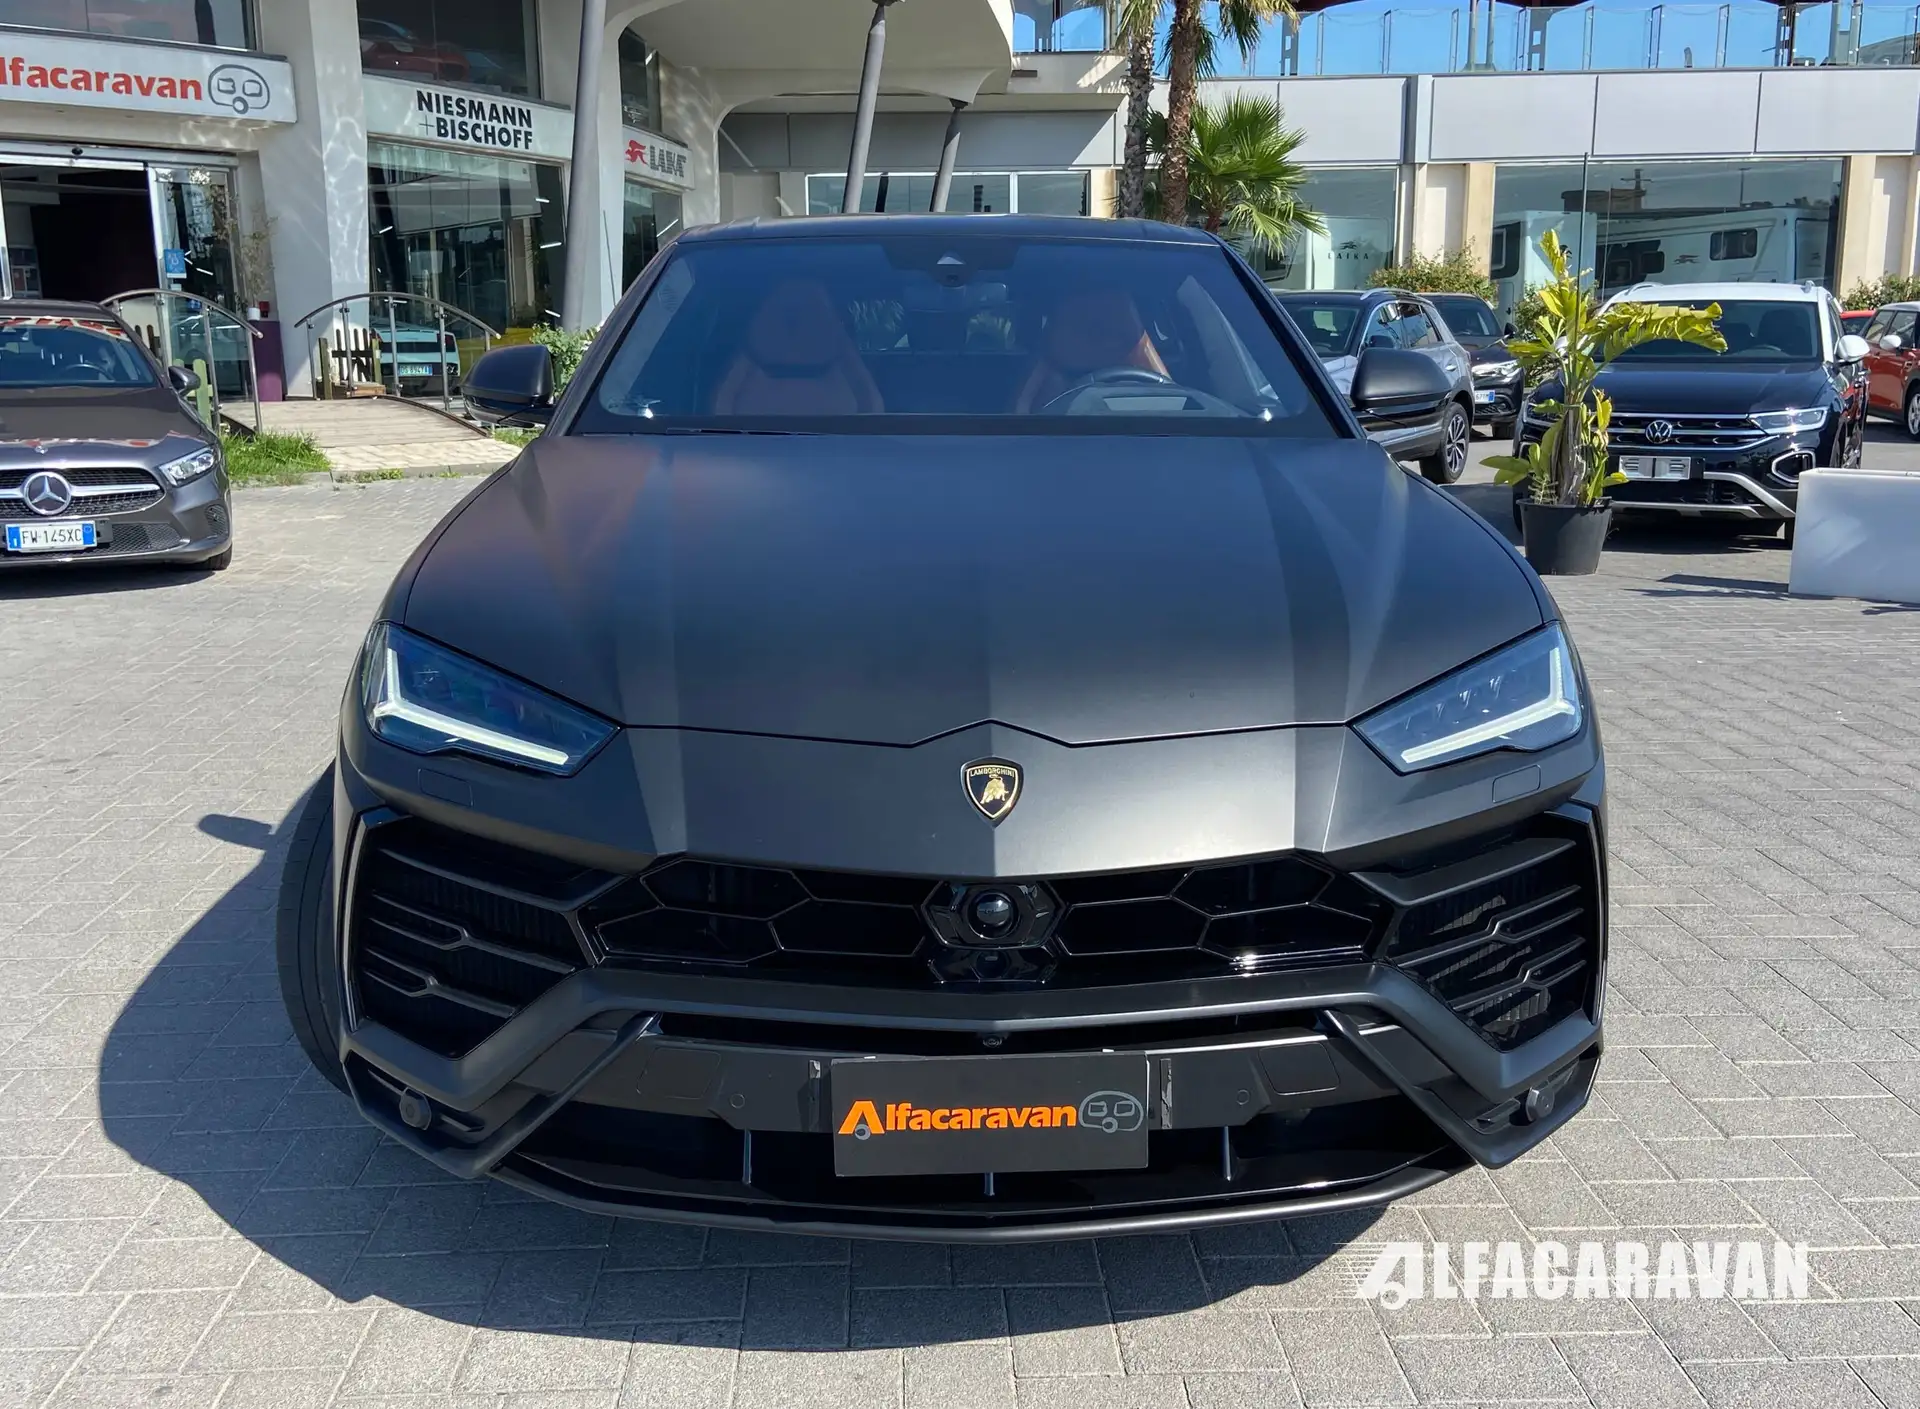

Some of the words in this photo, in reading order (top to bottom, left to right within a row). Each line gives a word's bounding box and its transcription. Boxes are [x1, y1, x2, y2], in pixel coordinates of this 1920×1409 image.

[0, 56, 203, 101] lfacaravan
[416, 90, 533, 128] NIESMANN
[1327, 252, 1369, 260] LAIKA
[970, 767, 1015, 778] LAMBORGHINI
[838, 1100, 1078, 1136] Alfacaravan
